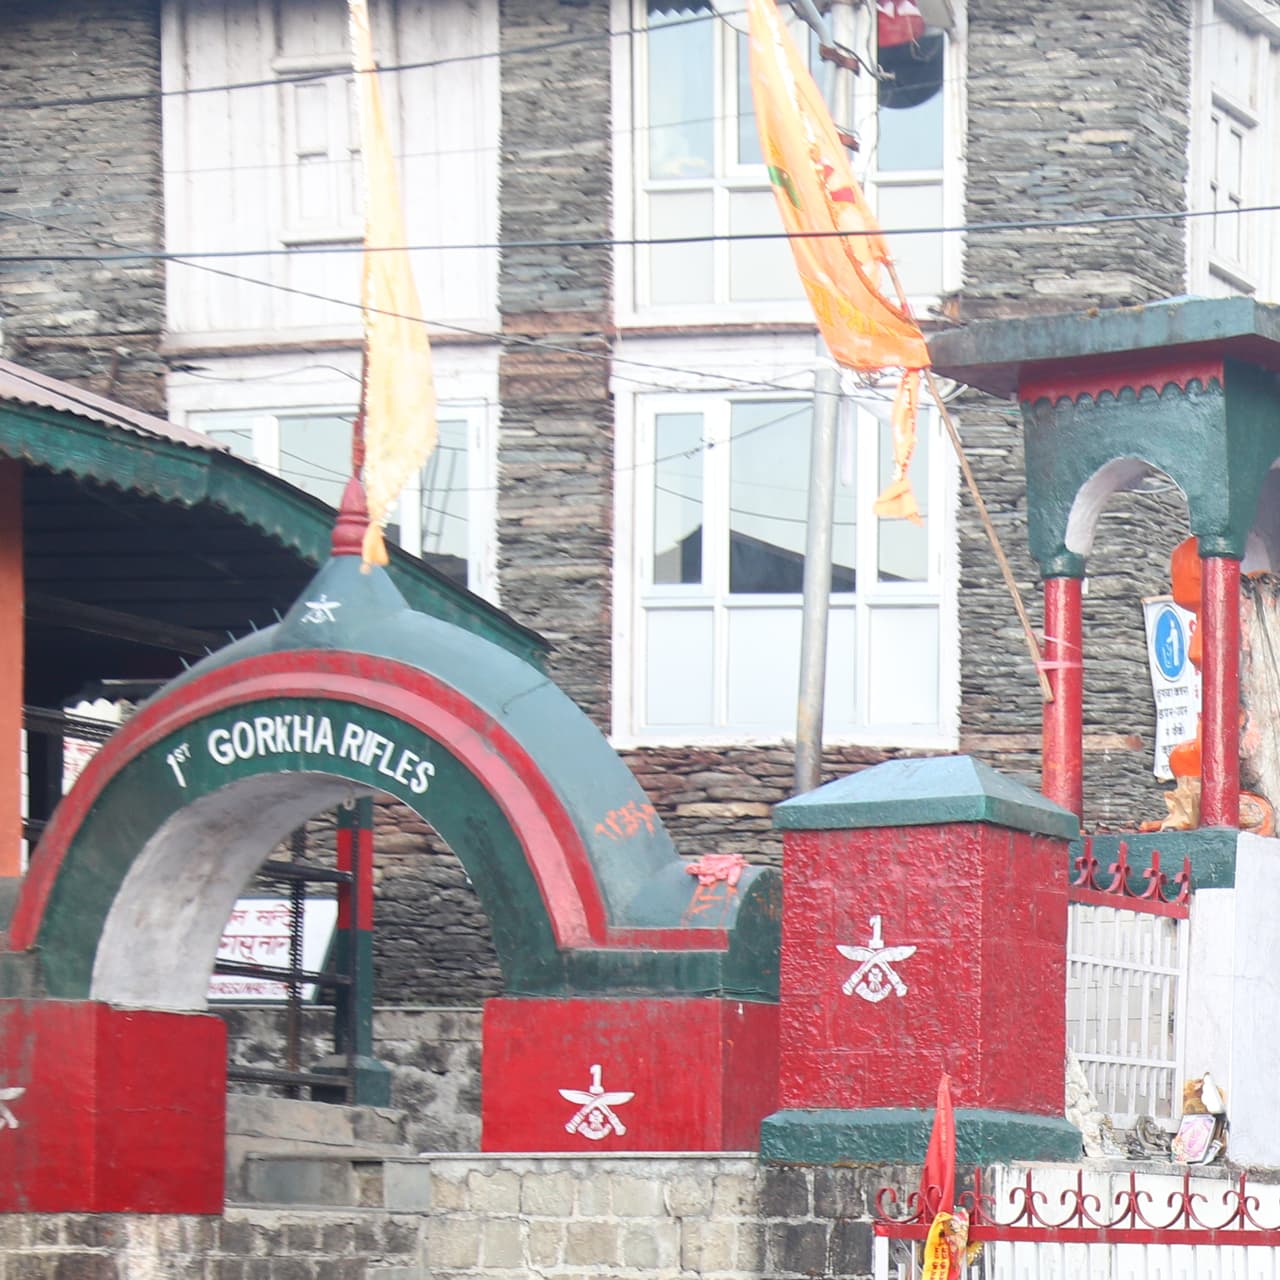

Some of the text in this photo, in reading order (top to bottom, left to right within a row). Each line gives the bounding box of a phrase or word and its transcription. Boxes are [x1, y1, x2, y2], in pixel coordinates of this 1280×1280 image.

[207, 715, 335, 765] GORKHA
[340, 722, 435, 793] RIFLES
[869, 915, 884, 949] 1
[589, 1064, 604, 1094] 1
